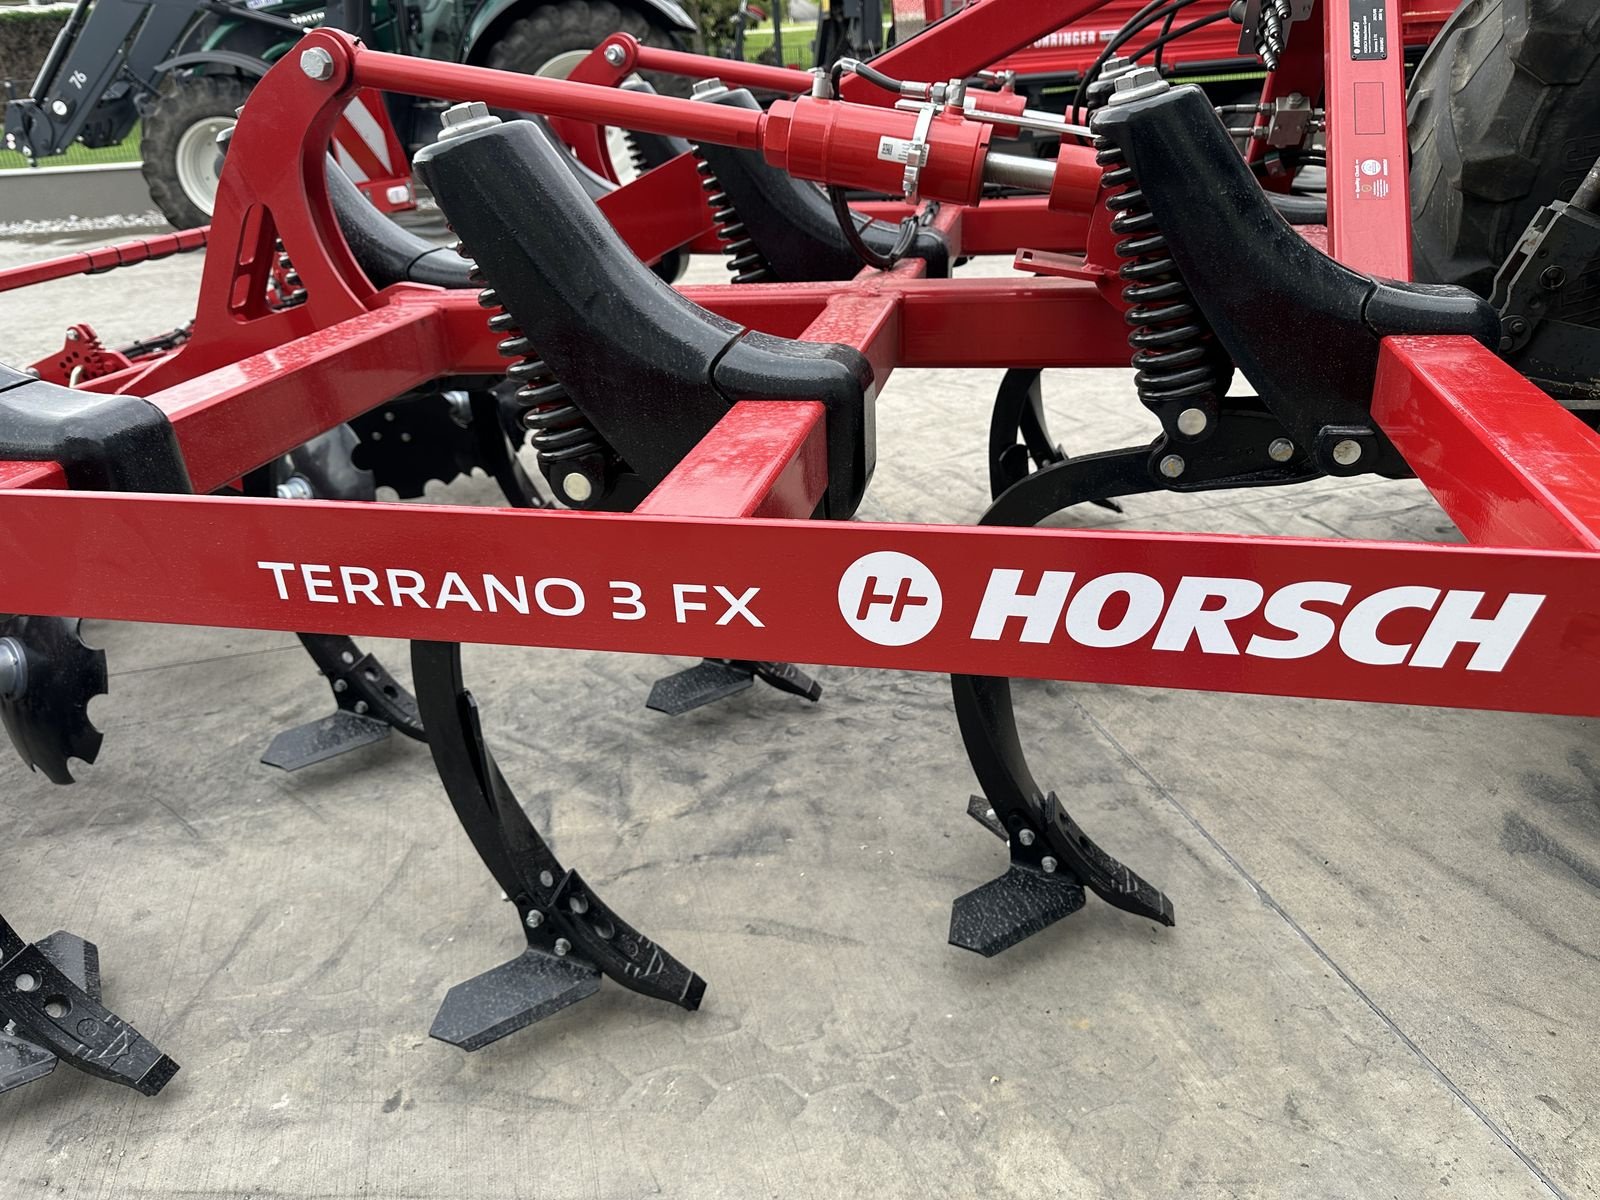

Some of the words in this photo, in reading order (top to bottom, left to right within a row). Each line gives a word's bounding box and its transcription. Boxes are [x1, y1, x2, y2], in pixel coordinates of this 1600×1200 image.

[1353, 21, 1361, 48] HORSCH
[69, 70, 87, 89] 76
[258, 561, 585, 617] TERRANO
[610, 581, 646, 621] 3
[673, 584, 765, 628] FX
[970, 568, 1546, 673] HORSCH
